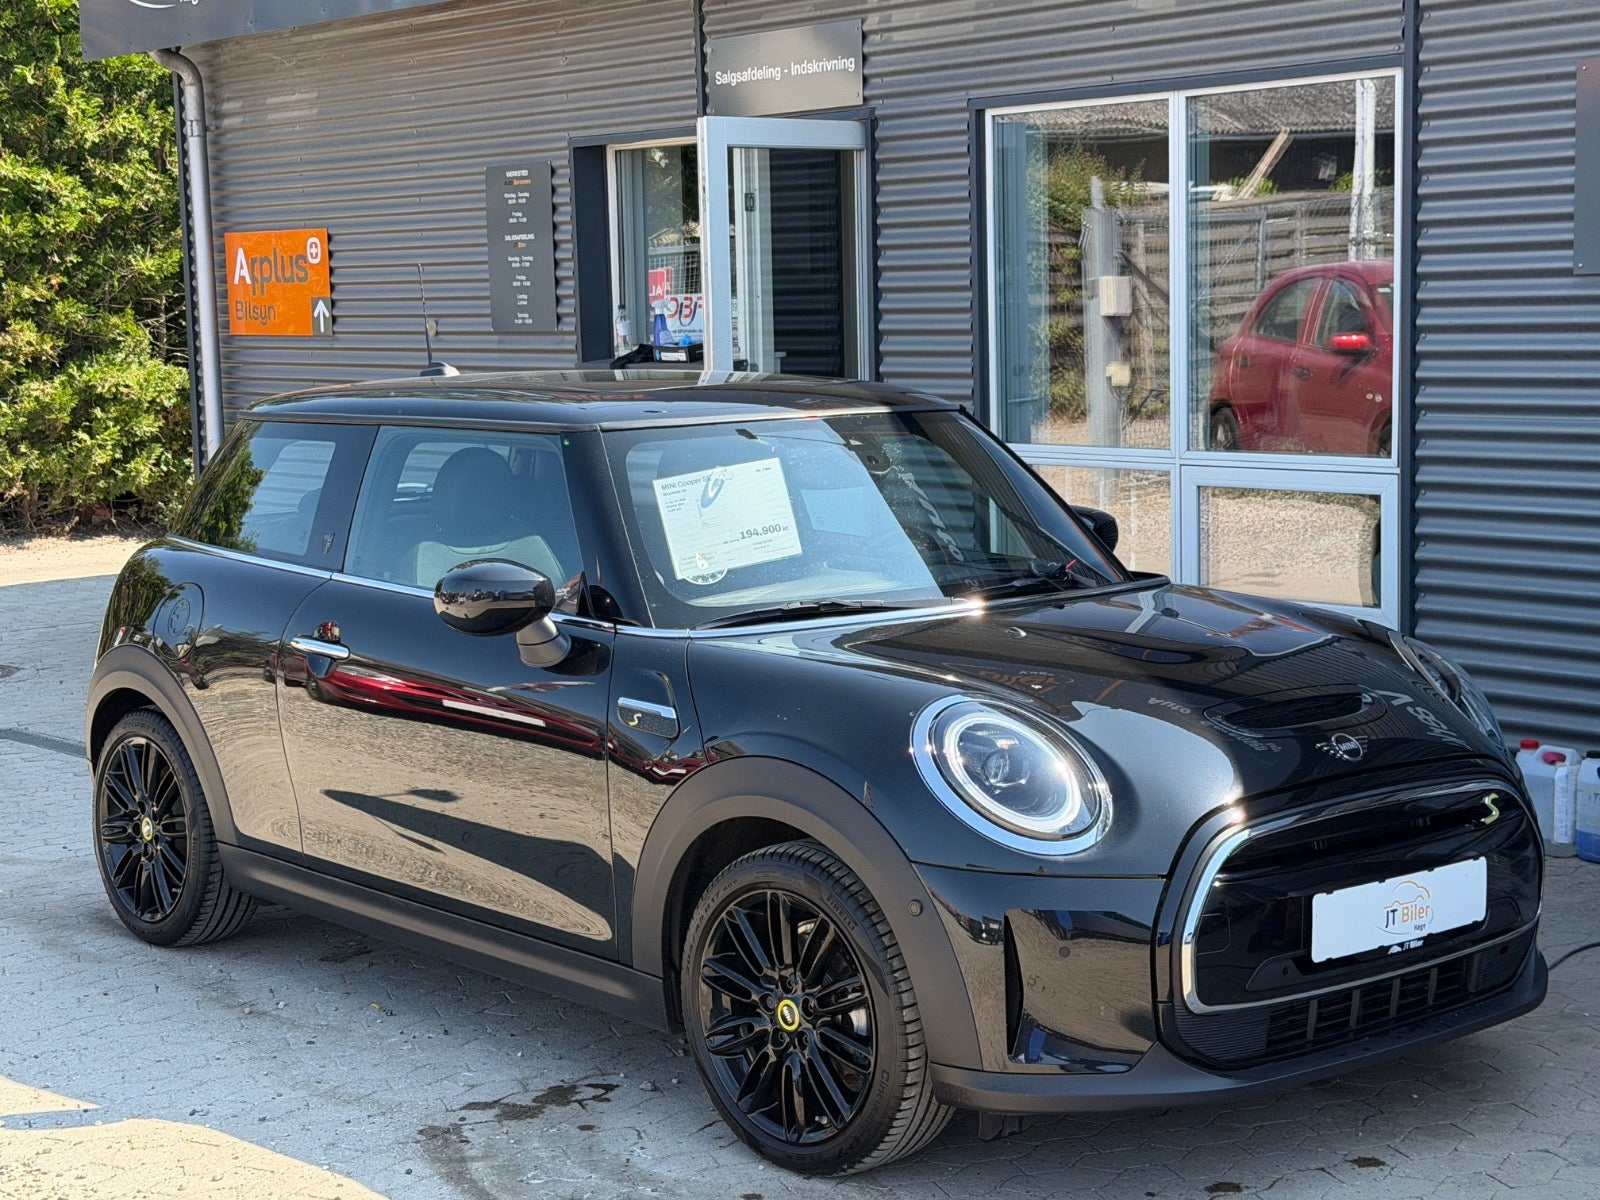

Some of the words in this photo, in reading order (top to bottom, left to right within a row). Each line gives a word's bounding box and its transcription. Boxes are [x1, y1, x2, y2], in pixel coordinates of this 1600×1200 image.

[715, 66, 781, 86] Salgsafdeling
[791, 56, 855, 76] Indskrivning
[233, 246, 309, 296] Applus
[235, 300, 276, 326] Bilsyn
[661, 482, 677, 490] MINI
[678, 477, 701, 488] Cooper
[740, 523, 782, 540] 194.900
[1385, 909, 1398, 928] JT
[1402, 903, 1430, 923] Biler
